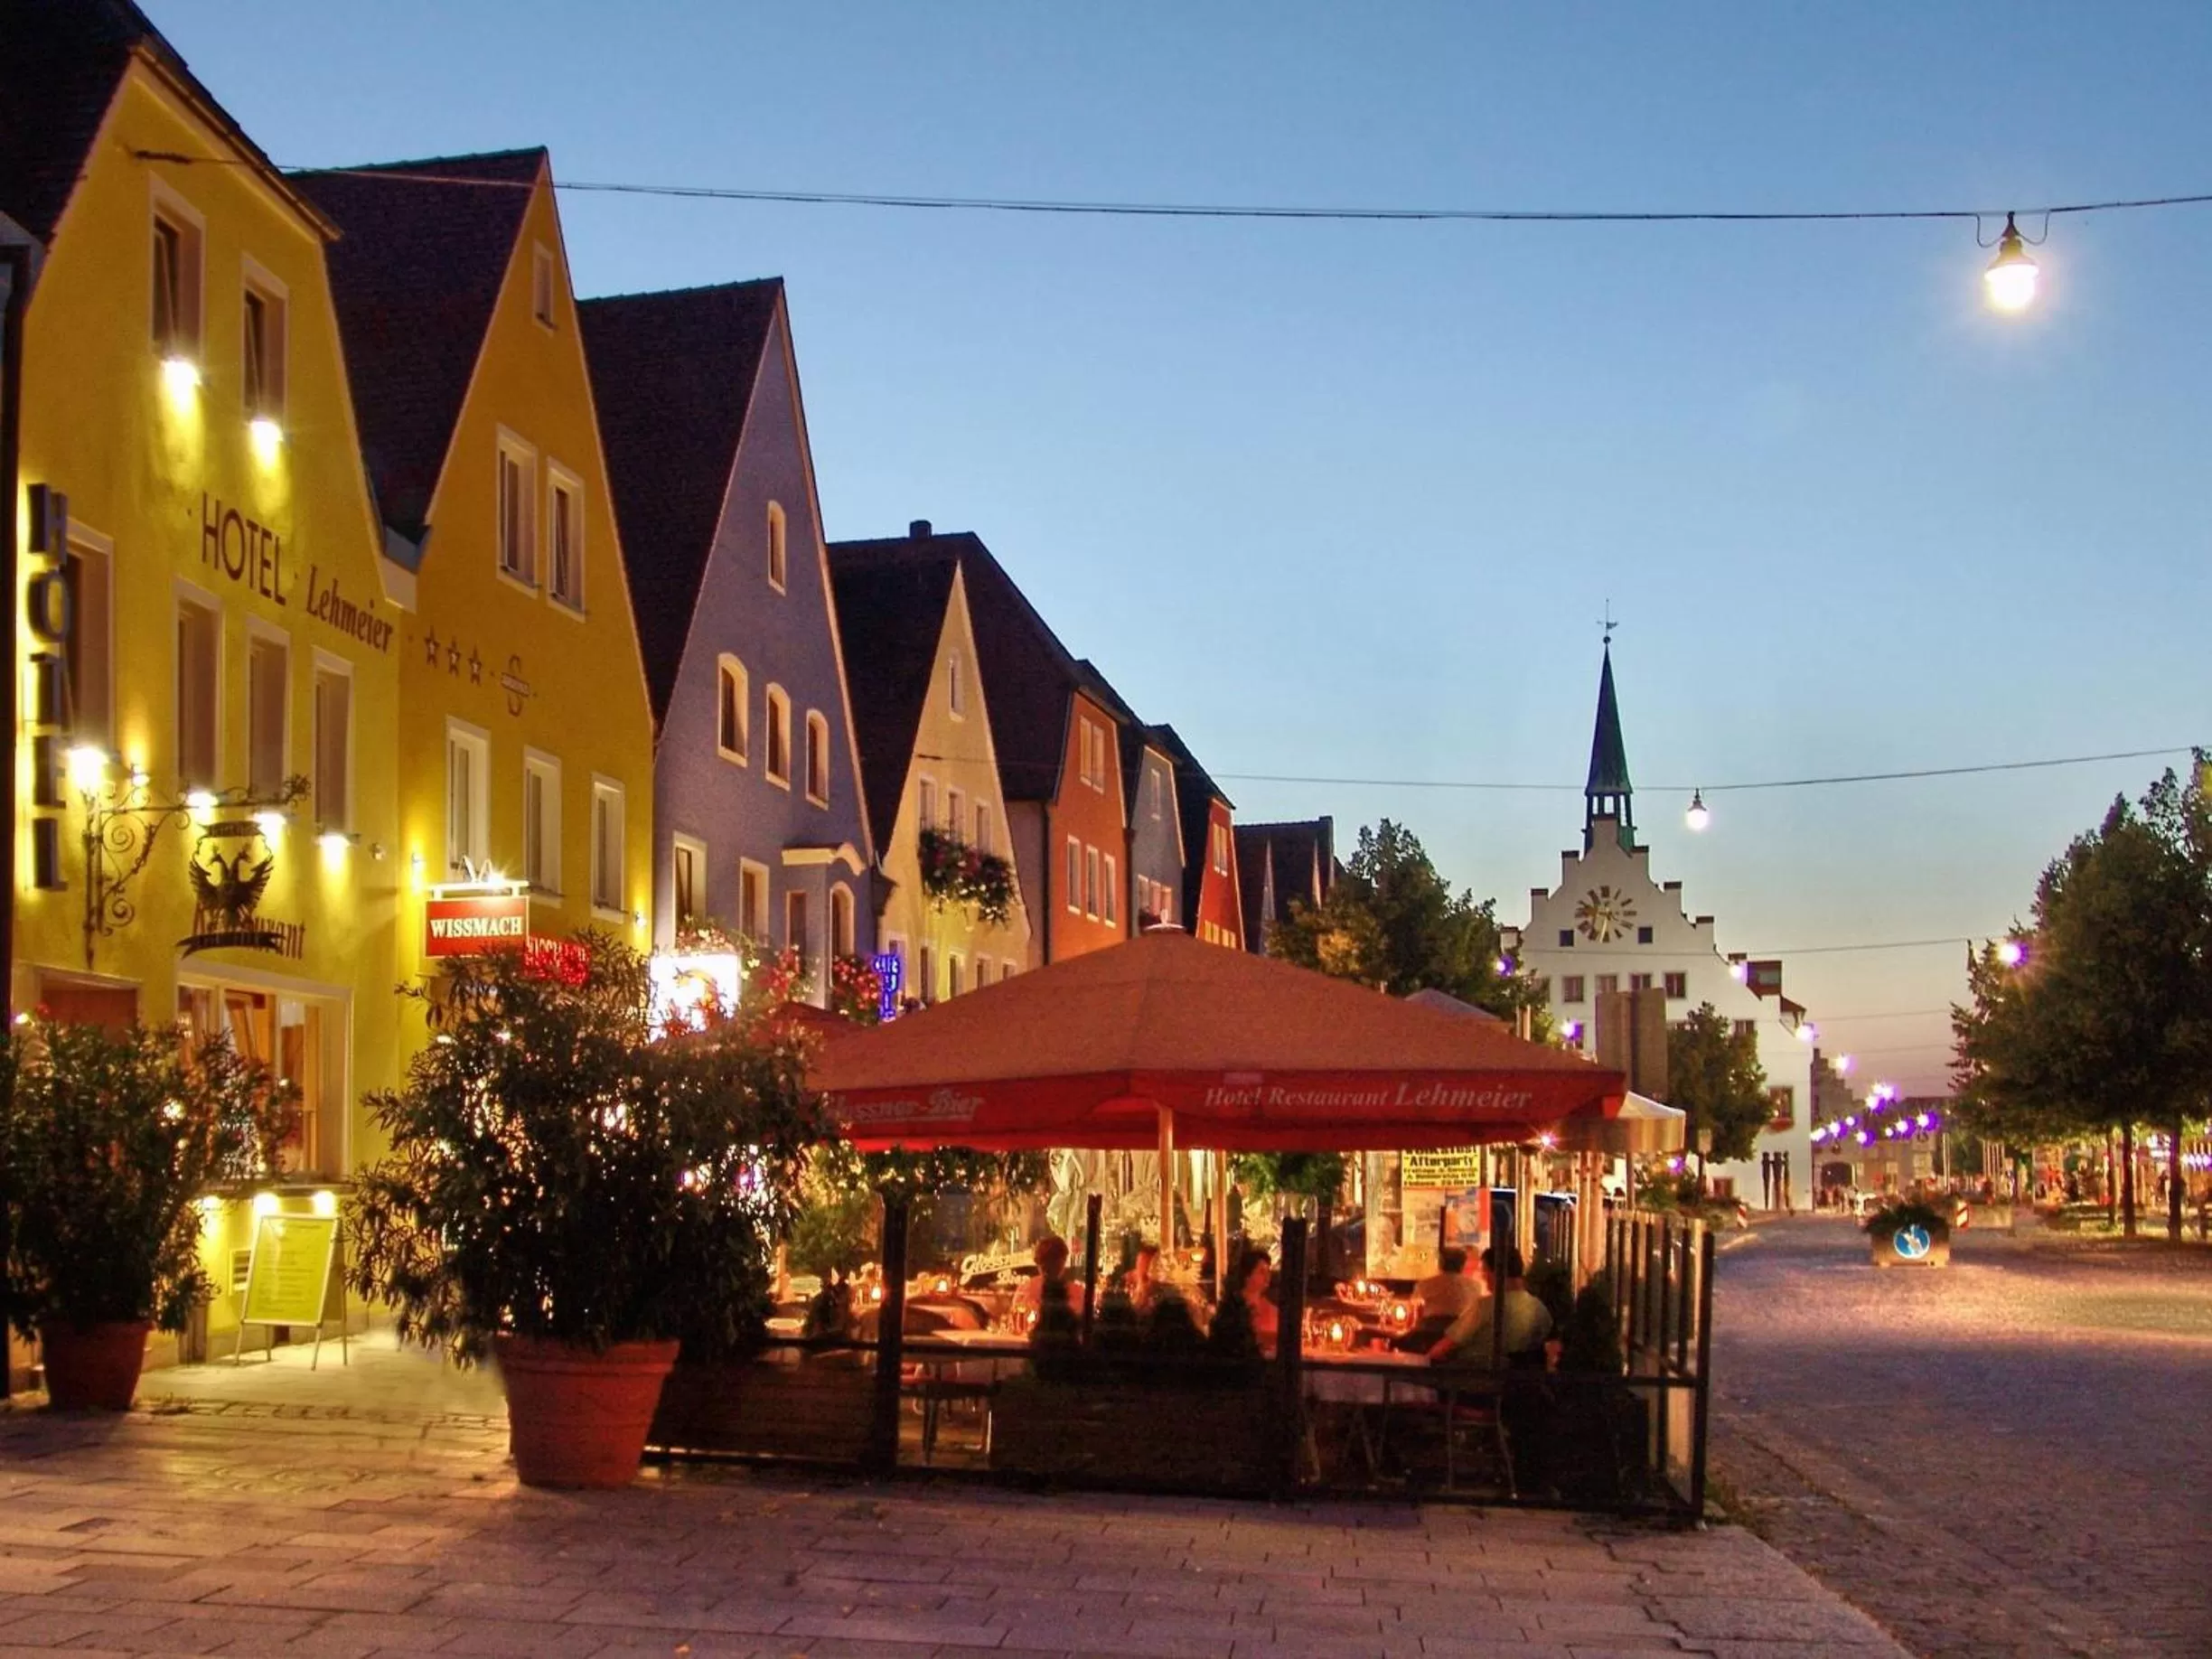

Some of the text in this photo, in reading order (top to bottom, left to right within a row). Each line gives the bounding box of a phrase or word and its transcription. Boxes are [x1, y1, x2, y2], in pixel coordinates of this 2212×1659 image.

[202, 491, 394, 654] HOTEL Lehmeier
[430, 916, 523, 938] WISSMACH
[1204, 1083, 1532, 1110] Hotel Restaurant Lehmeier
